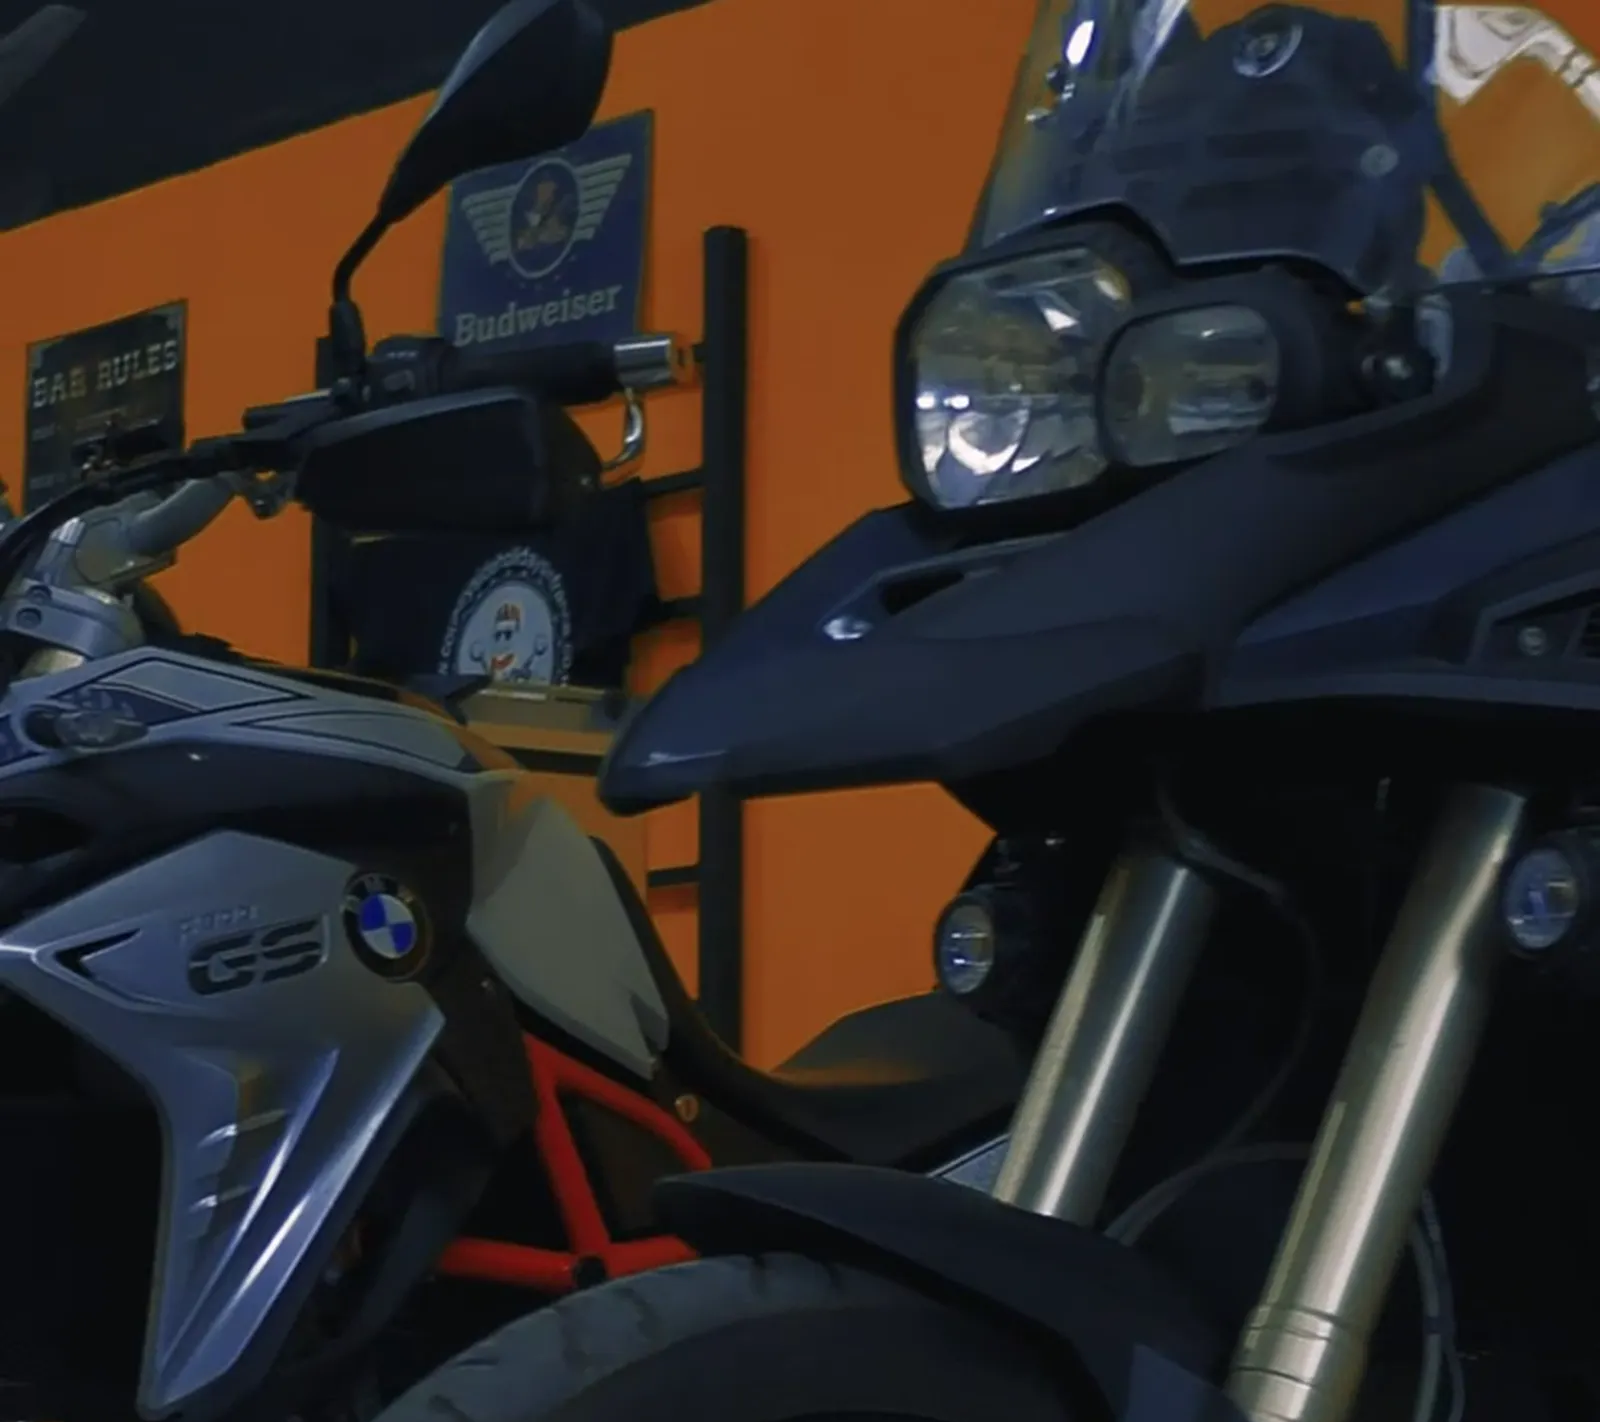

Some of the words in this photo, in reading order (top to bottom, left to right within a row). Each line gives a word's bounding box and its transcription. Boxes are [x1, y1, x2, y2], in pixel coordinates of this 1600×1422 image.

[453, 285, 622, 347] Budweiser
[97, 339, 177, 390] RULES
[188, 919, 322, 996] GS
